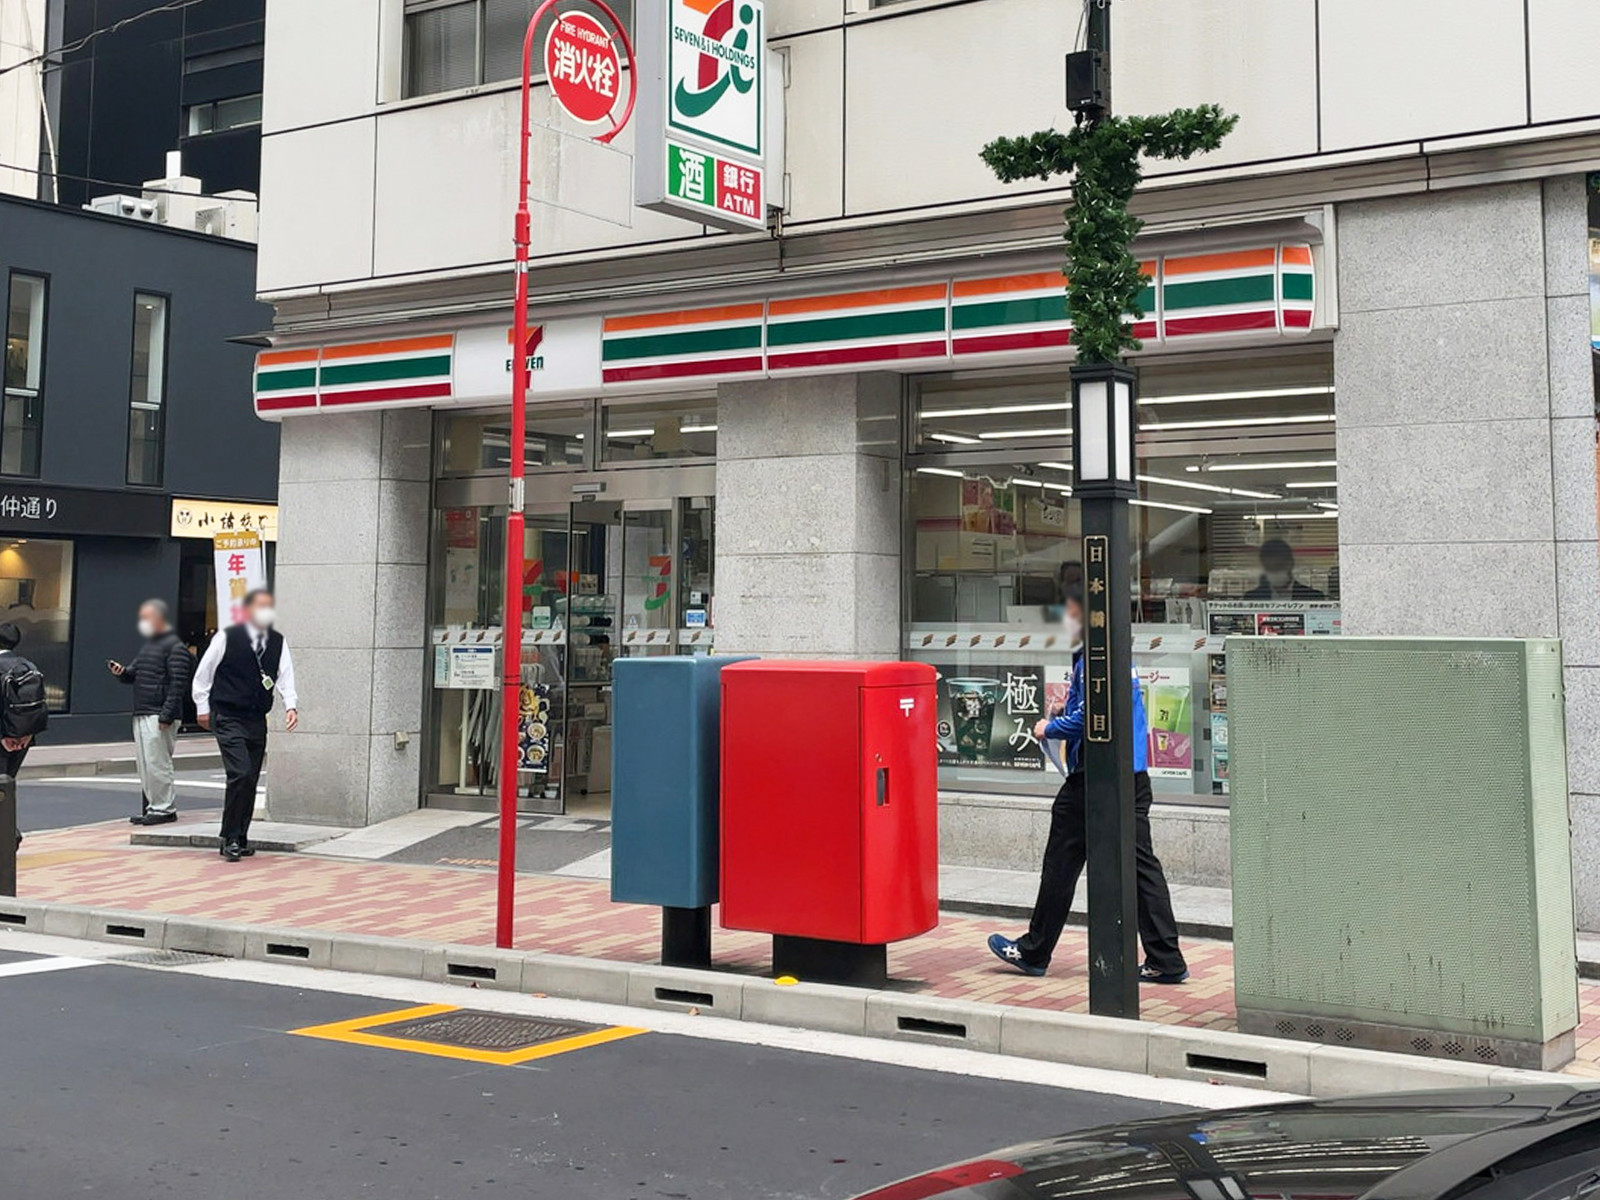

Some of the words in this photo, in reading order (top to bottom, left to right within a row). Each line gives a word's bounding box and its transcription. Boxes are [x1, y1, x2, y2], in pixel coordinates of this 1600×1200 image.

[560, 20, 576, 37] FIRE
[577, 27, 609, 49] HYDRANT
[553, 37, 615, 98] 消火栓
[712, 41, 755, 70] HOLDINGS
[679, 148, 706, 201] 酒
[723, 163, 754, 194] 銀行
[723, 192, 754, 216] ATM
[1, 494, 57, 519] 仲通り
[1000, 671, 1040, 752] 極み
